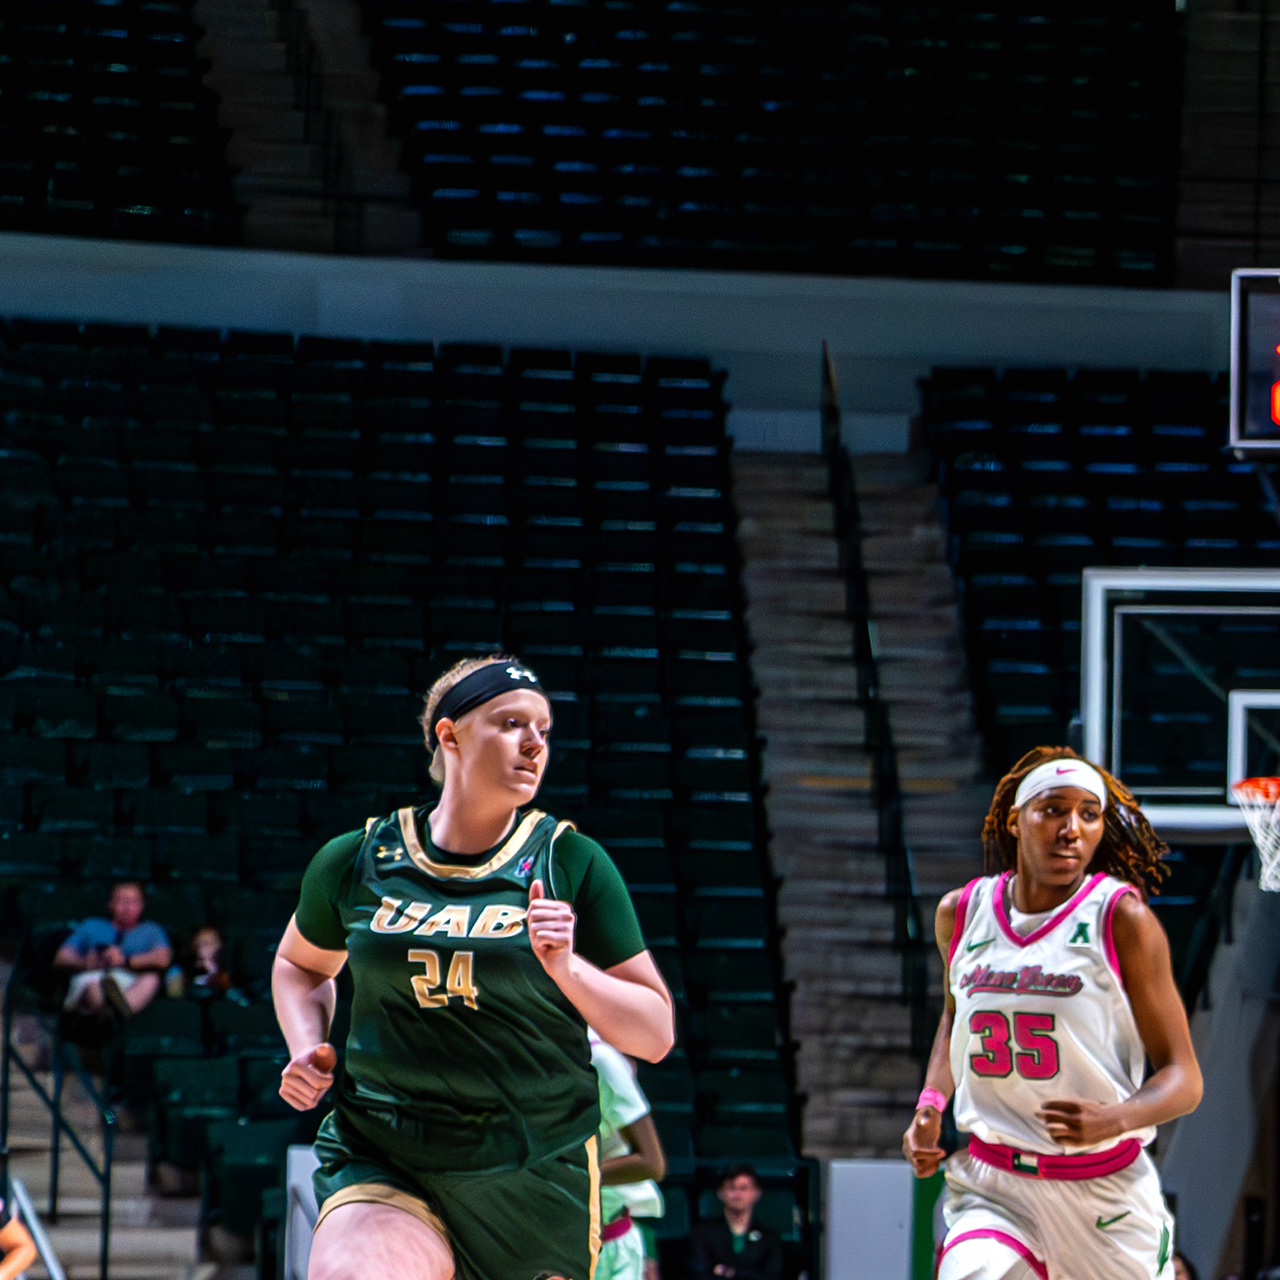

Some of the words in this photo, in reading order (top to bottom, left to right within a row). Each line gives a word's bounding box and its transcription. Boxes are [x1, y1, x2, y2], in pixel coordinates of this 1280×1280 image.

[370, 896, 527, 938] UAB
[408, 949, 479, 1010] 24
[969, 1010, 1060, 1080] 35
